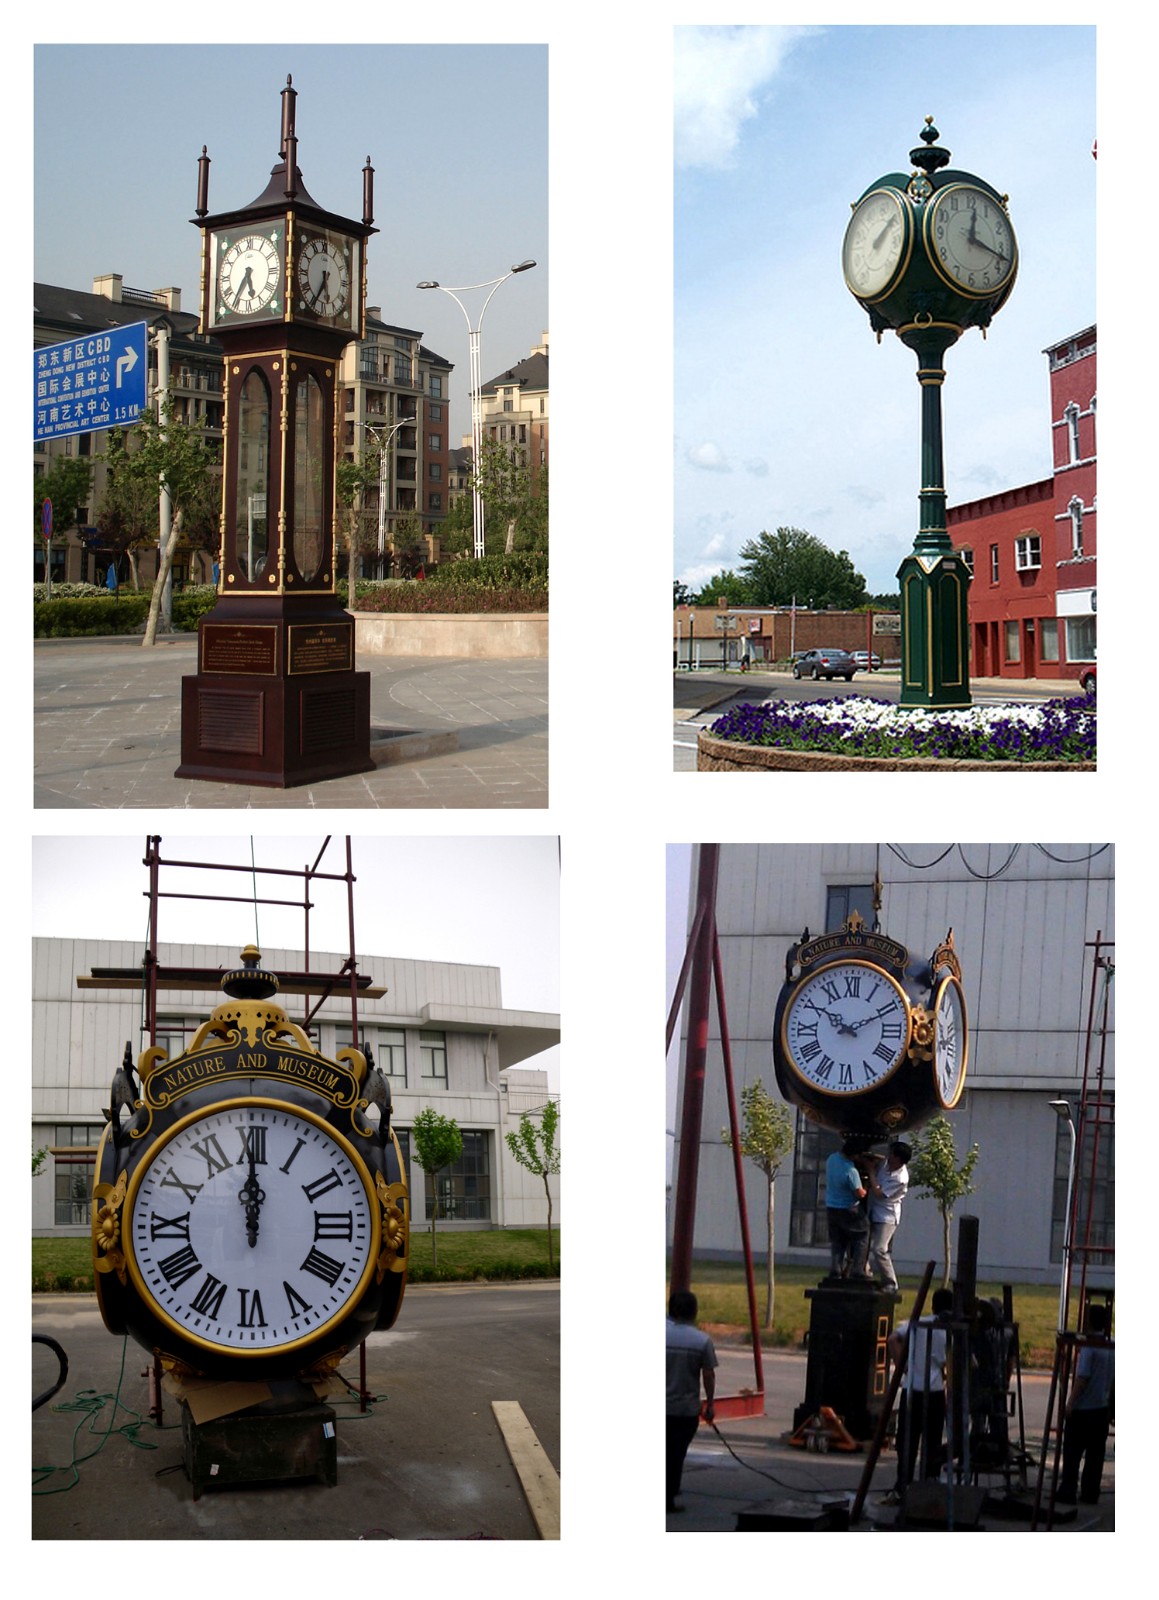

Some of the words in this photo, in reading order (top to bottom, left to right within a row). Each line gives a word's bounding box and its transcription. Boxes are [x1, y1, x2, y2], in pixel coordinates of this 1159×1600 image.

[38, 367, 110, 397] 国际会展中心
[38, 397, 110, 425] 河南艺术中心
[115, 406, 126, 420] 1.5
[128, 403, 139, 418] KM
[809, 938, 841, 957] NATURE
[845, 936, 862, 946] AND
[866, 937, 899, 957] MUSEUM
[820, 980, 842, 1005] XI
[843, 976, 862, 998] XII
[797, 1021, 818, 1038] IX
[881, 1023, 902, 1040] III
[799, 1039, 822, 1063] VIII
[163, 1056, 226, 1091] NATURE
[236, 1053, 267, 1069] AND
[277, 1055, 340, 1090] MUSEUM
[814, 1054, 834, 1080] VII
[838, 1063, 854, 1085] VI
[862, 1059, 877, 1080] V
[191, 1133, 233, 1180] XI
[235, 1125, 268, 1165] XII
[279, 1137, 306, 1175] I
[160, 1167, 204, 1205] X
[301, 1168, 343, 1204] II
[151, 1211, 190, 1242] IX
[314, 1210, 352, 1243] III
[157, 1243, 203, 1292] VIII
[300, 1244, 346, 1288] IIII
[189, 1272, 228, 1321] VII
[237, 1288, 268, 1328] VI
[282, 1281, 312, 1319] V
